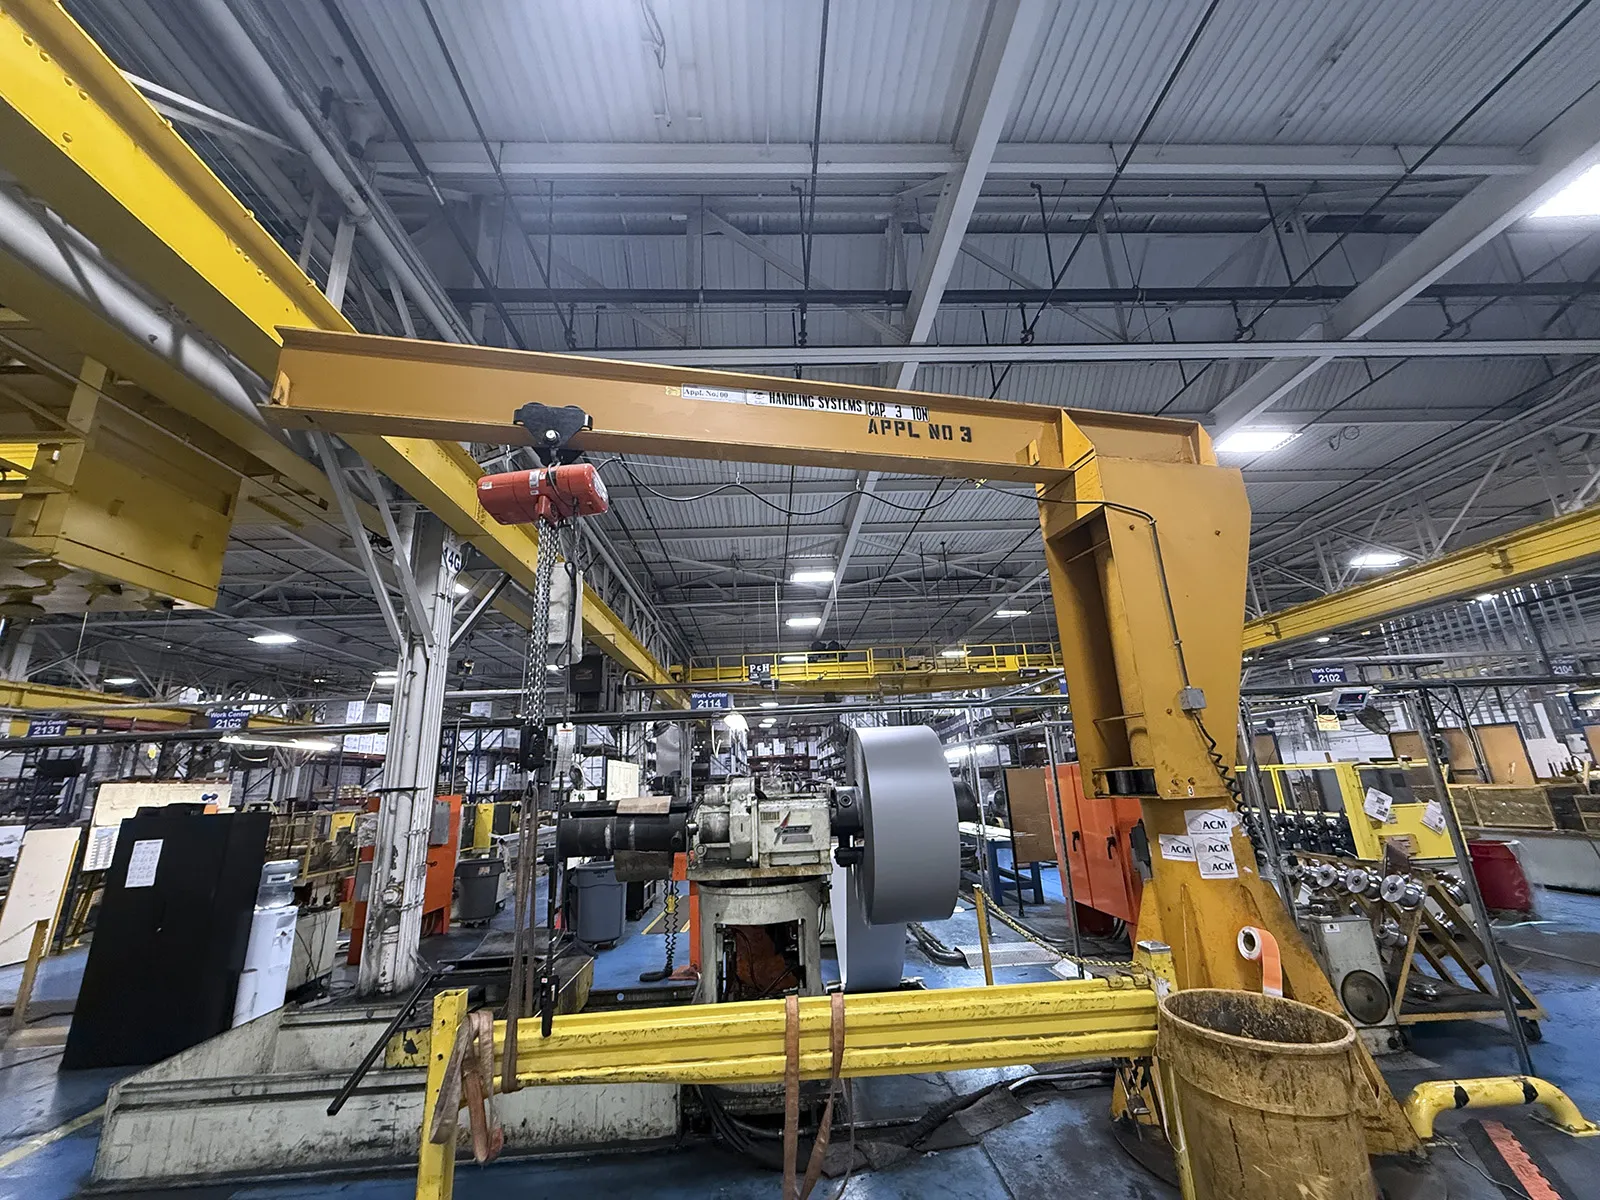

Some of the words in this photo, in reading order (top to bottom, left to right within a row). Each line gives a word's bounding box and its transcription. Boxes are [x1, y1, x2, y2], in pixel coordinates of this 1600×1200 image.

[769, 391, 815, 407] HANDLING
[818, 397, 863, 412] SYSTEMS
[868, 401, 887, 418] CAP.
[895, 405, 903, 418] 3
[912, 406, 929, 421] TON
[868, 419, 920, 438] APPL
[928, 423, 953, 441] NO
[960, 426, 973, 443] 3
[1318, 673, 1341, 683] 2102
[698, 699, 721, 709] 2114
[228, 710, 250, 718] Center
[33, 725, 60, 735] 2131
